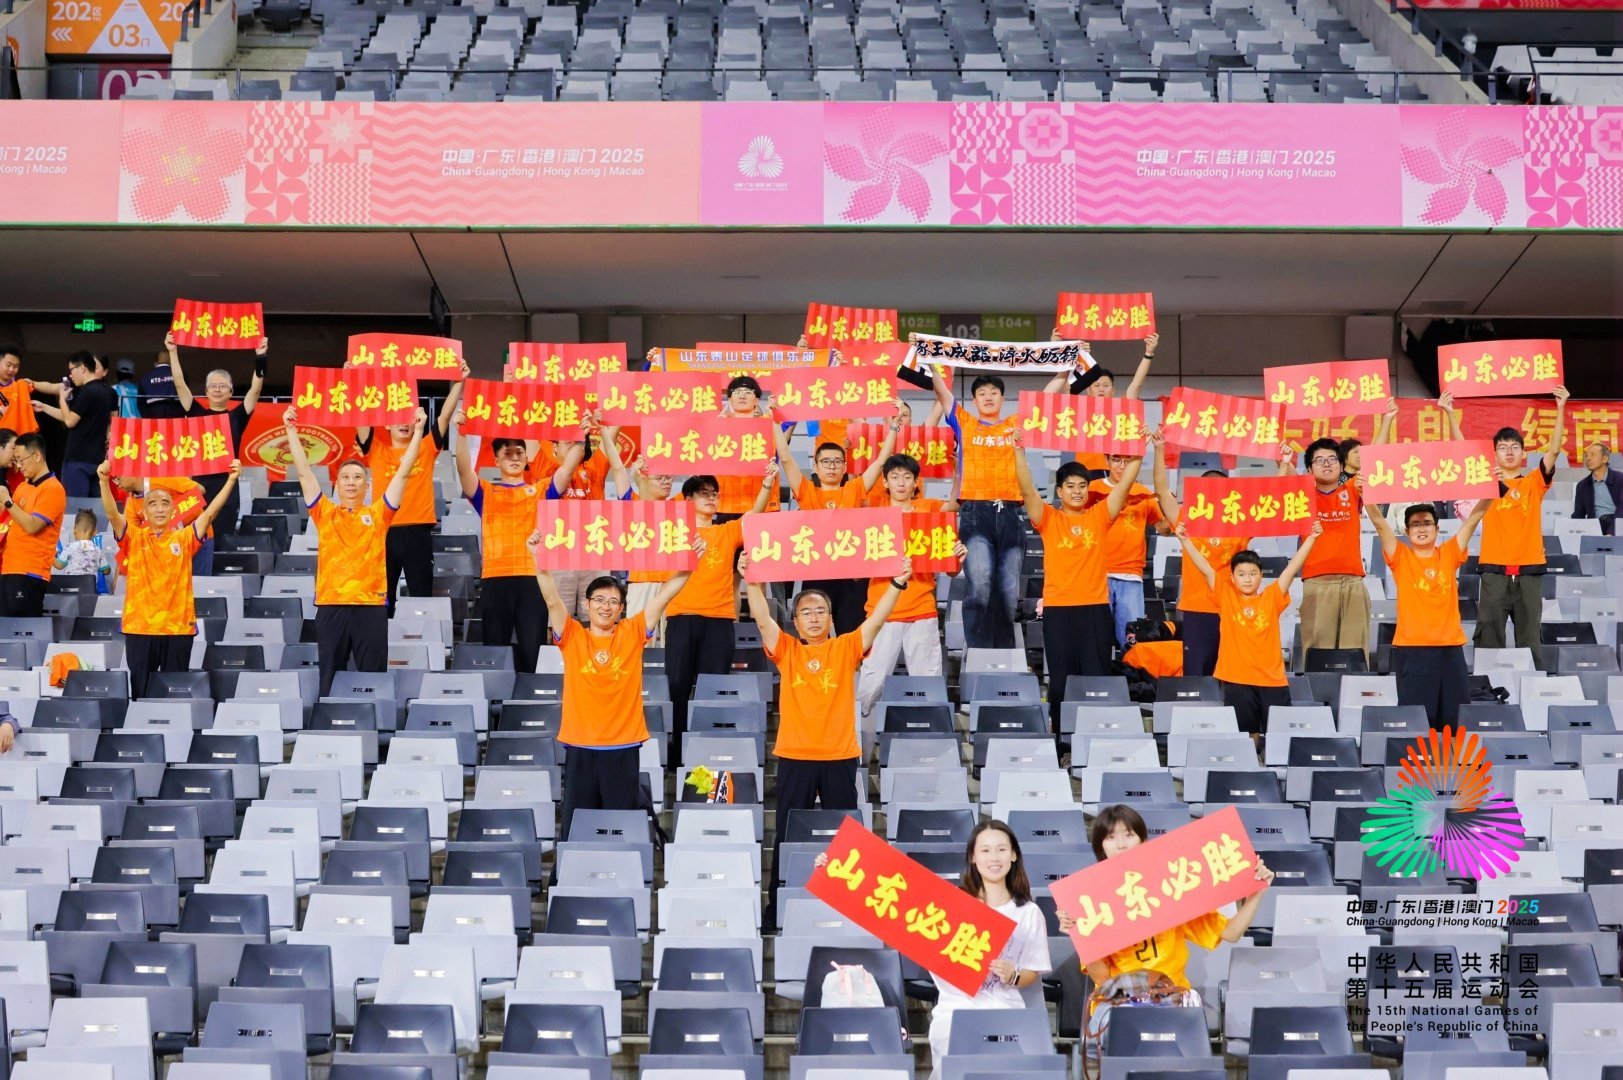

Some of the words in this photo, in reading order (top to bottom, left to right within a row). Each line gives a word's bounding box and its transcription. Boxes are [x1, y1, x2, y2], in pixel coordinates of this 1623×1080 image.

[24, 146, 68, 161] 2025
[32, 164, 68, 174] Macao
[600, 148, 644, 163] 2025
[1293, 149, 1335, 164] 2025
[543, 166, 570, 178] Hong
[574, 166, 600, 177] Kong
[609, 166, 645, 176] Macao
[1237, 167, 1264, 179] Hong
[1267, 167, 1293, 179] Kong
[1302, 168, 1336, 178] Macao
[172, 311, 260, 338] 山东必胜
[808, 315, 894, 344] 山东必胜
[901, 317, 923, 328] 102
[945, 325, 980, 340] 103
[999, 317, 1021, 328] 104
[1059, 304, 1151, 330] 山东必胜
[351, 342, 458, 369] 山东必胜
[514, 354, 622, 384] 山东必胜
[1443, 352, 1559, 385] 山东必胜
[296, 381, 414, 415] 山东必胜
[602, 383, 718, 415] 山东必胜
[776, 377, 894, 409] 山东必胜
[1270, 372, 1387, 408] 山东必胜
[466, 395, 581, 428] 山东必胜
[1022, 405, 1143, 442] 山东必胜
[1165, 401, 1280, 445] 山东必胜
[113, 429, 229, 465] 山东必胜
[646, 429, 769, 464] 山东必胜
[852, 436, 948, 465] 山必胜
[1367, 454, 1494, 490] 山东必胜
[1187, 490, 1312, 525] 山东必胜
[544, 515, 692, 556] 山东必胜
[751, 523, 900, 566] 山东必胜
[1078, 833, 1252, 937] 山东必胜
[826, 848, 993, 972] 山东必胜
